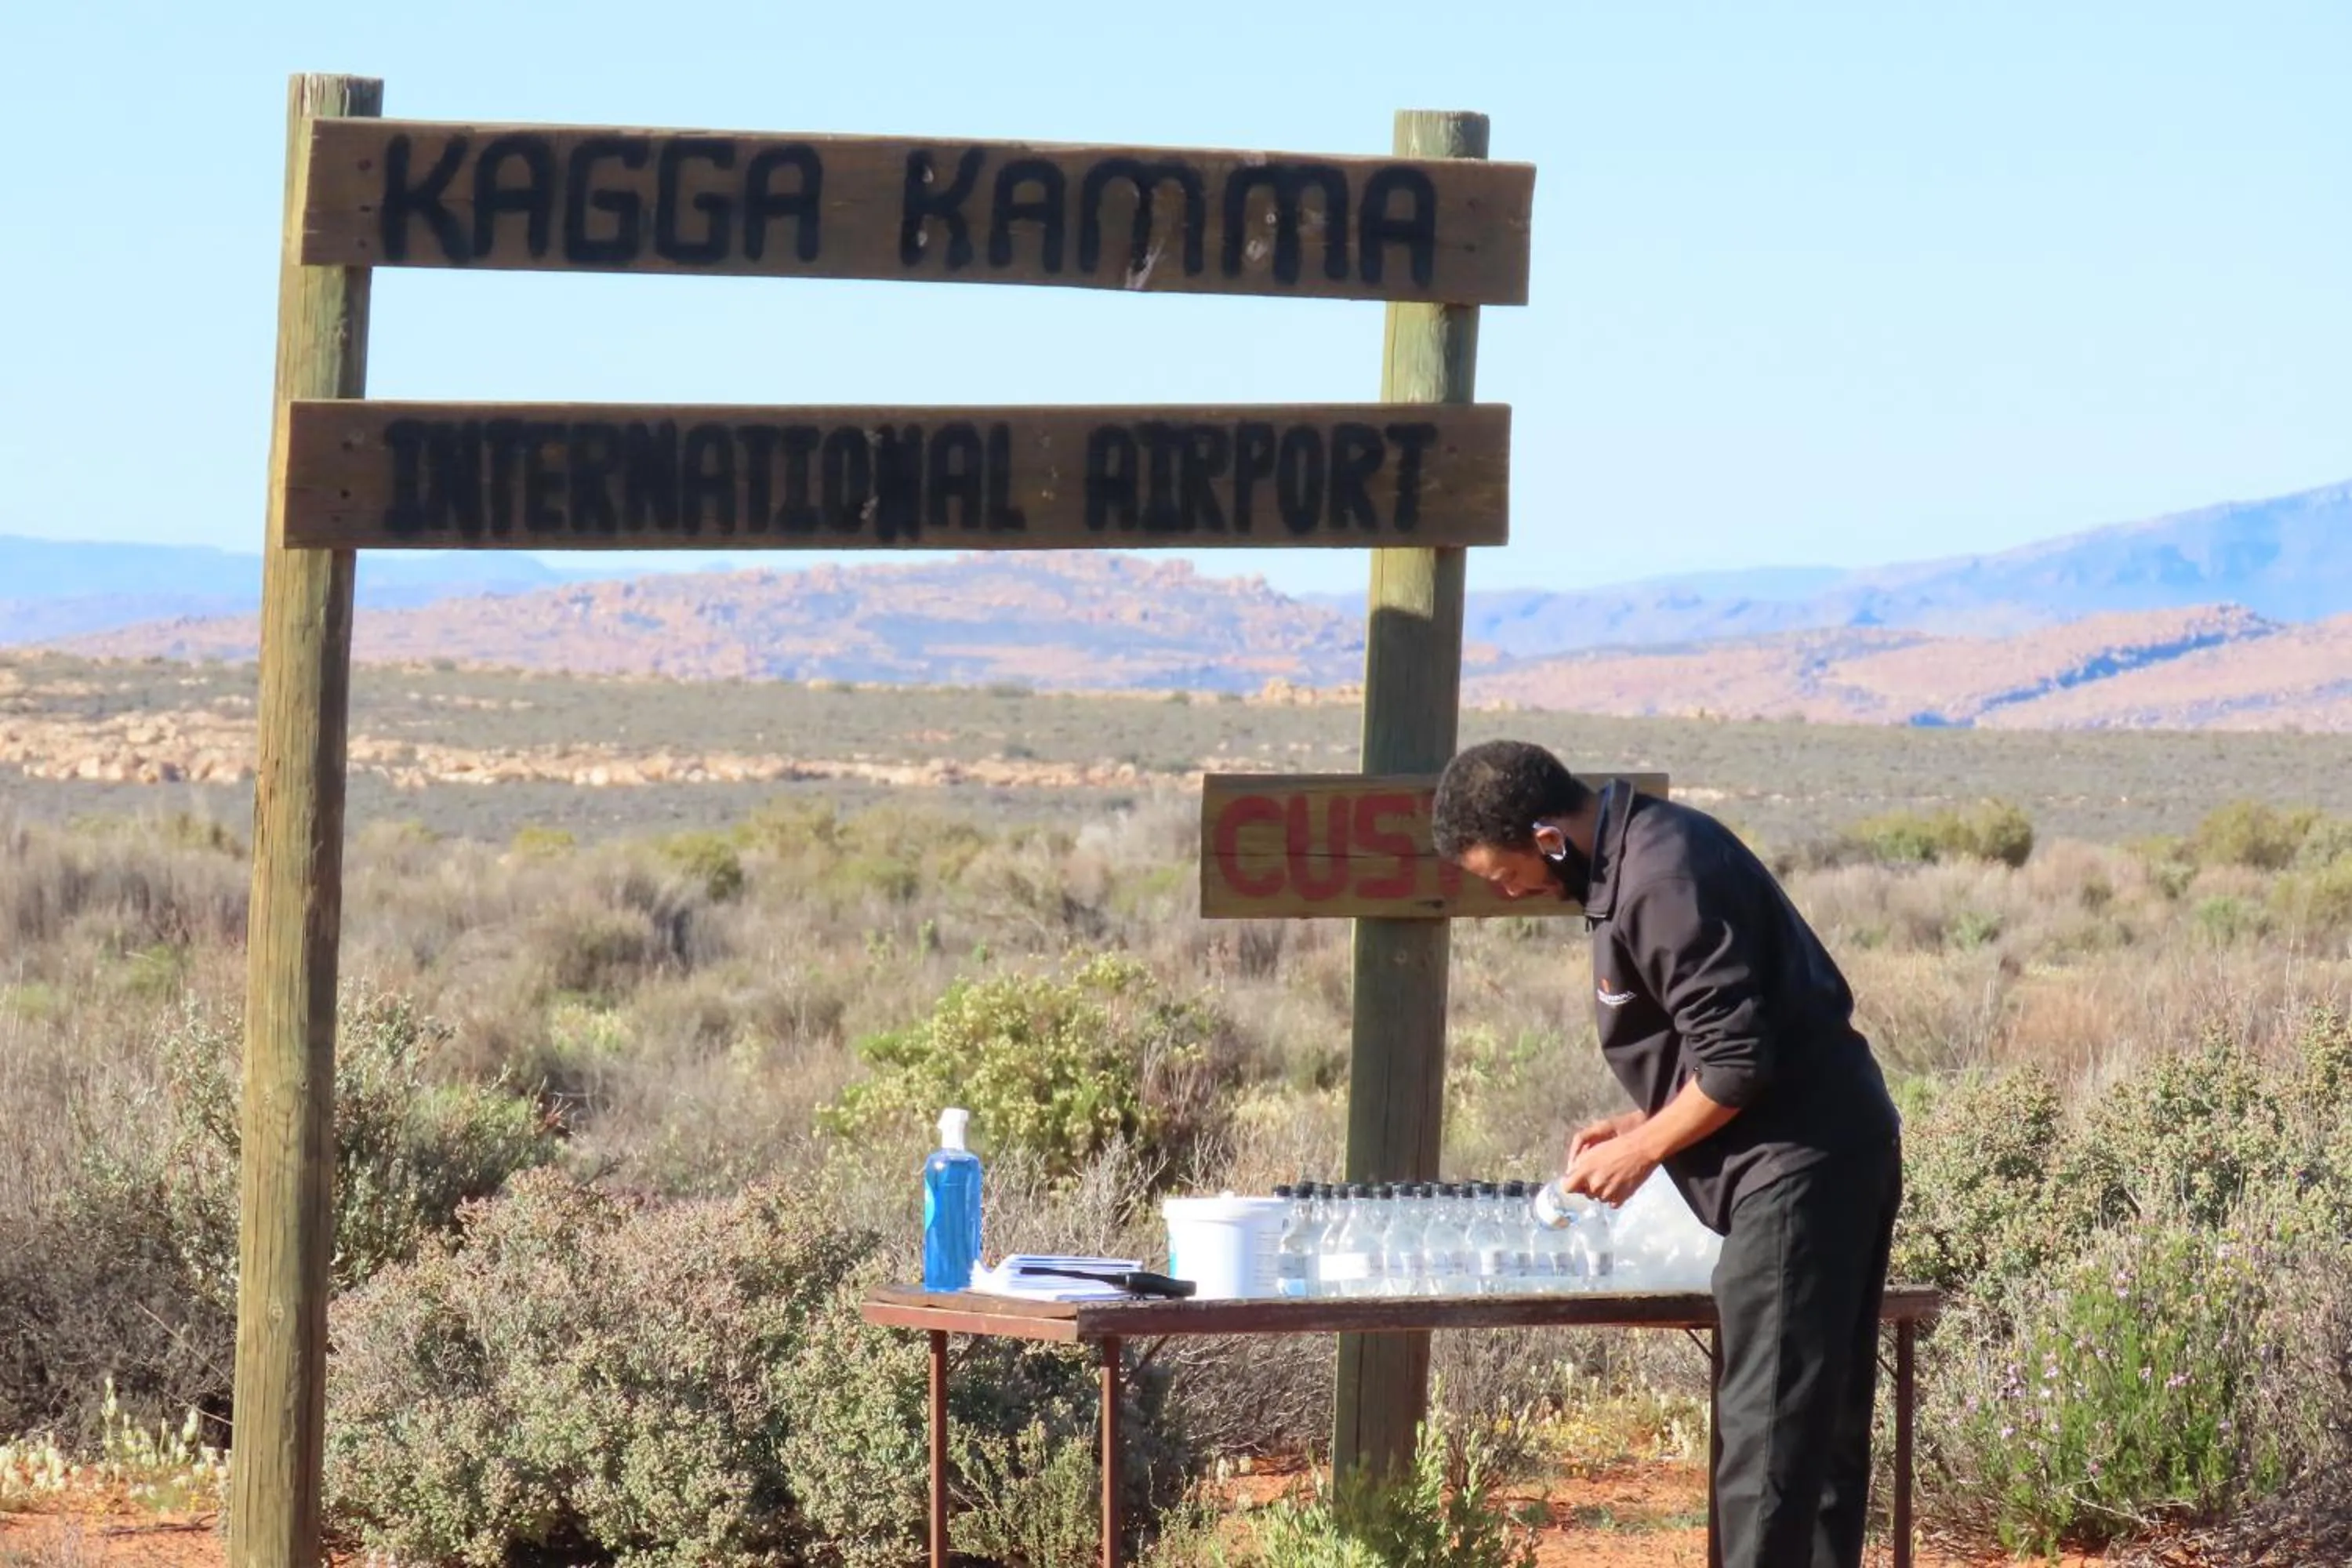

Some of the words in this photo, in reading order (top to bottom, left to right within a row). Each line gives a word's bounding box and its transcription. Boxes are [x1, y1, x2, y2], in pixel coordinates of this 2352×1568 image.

[379, 132, 823, 267] KAGGA
[900, 146, 1436, 287] KAMMA
[382, 419, 1027, 543] INTERNATIONAL
[1083, 419, 1439, 535] AIRPORT
